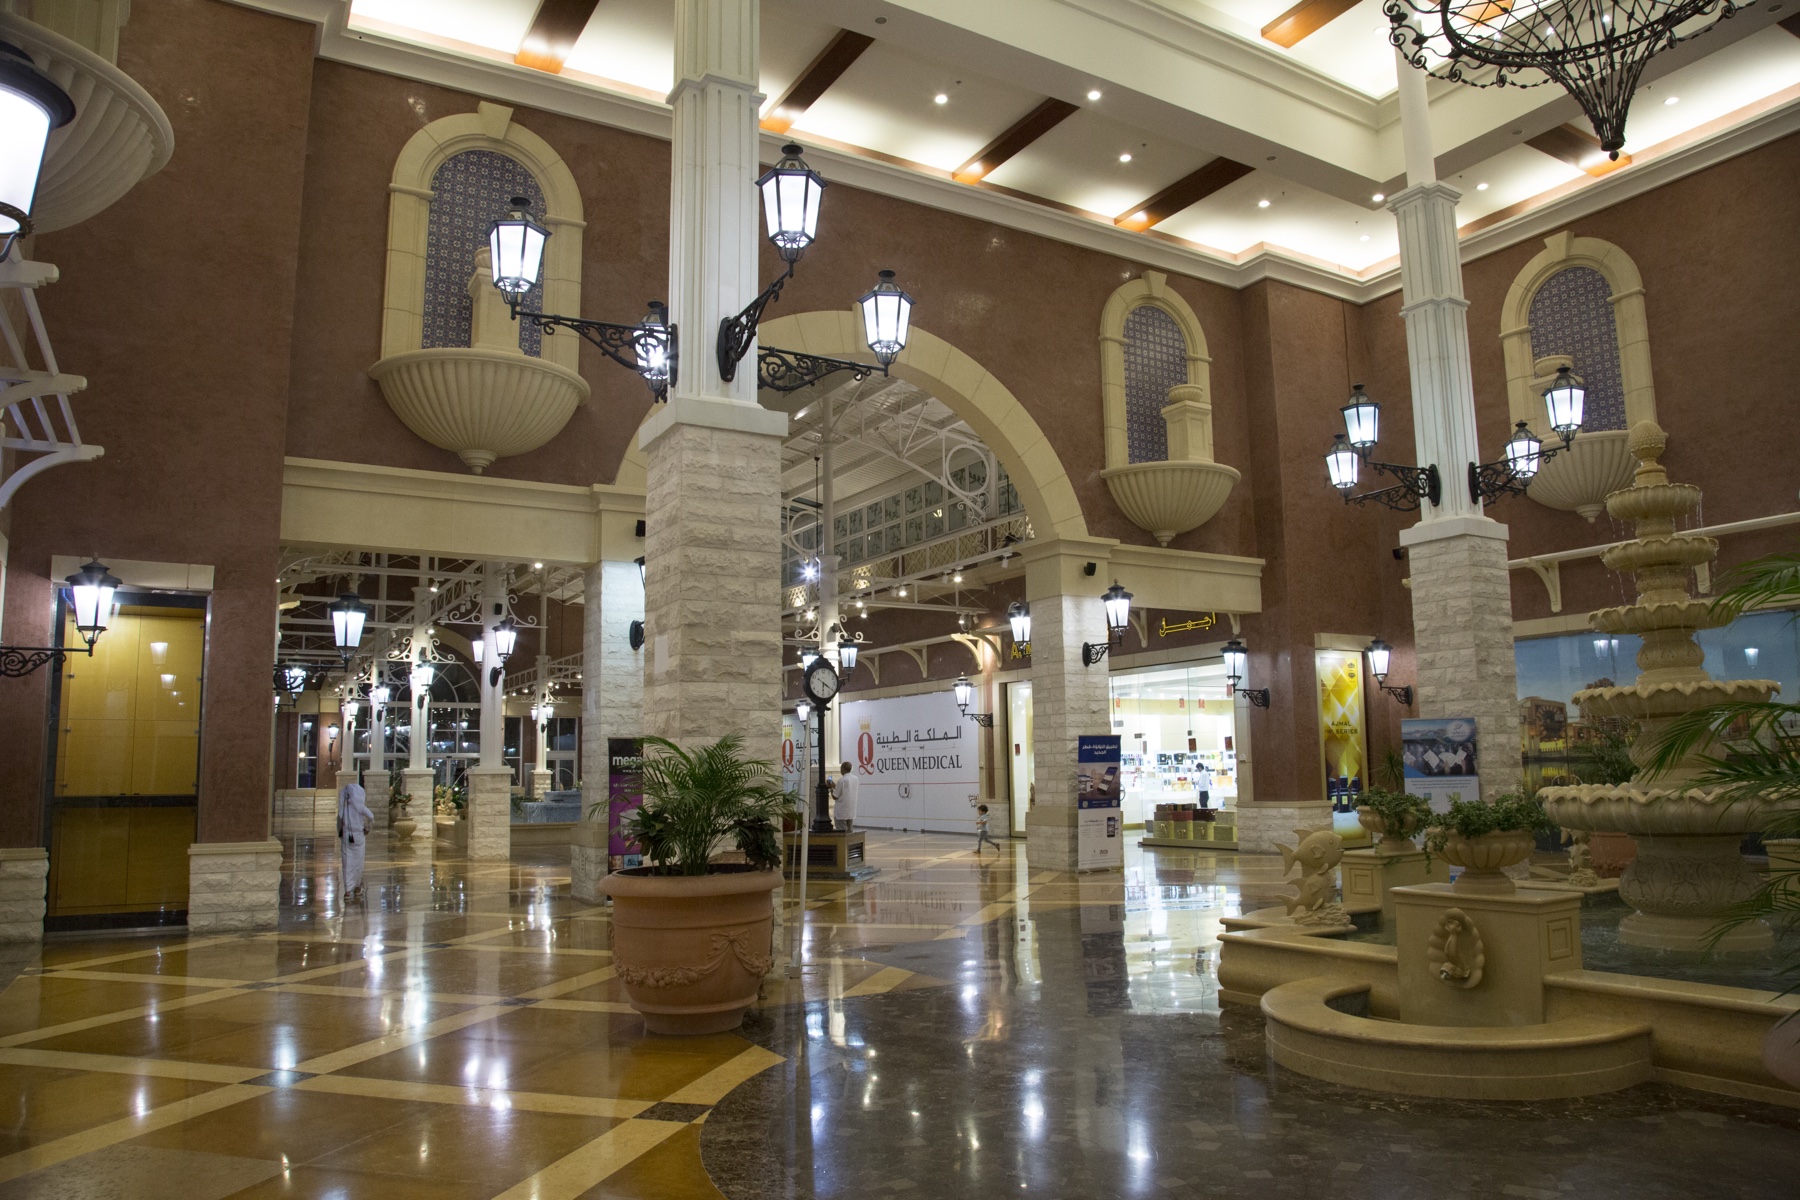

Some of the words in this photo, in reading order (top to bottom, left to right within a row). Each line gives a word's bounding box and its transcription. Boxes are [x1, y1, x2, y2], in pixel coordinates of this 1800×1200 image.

[876, 729, 912, 749] الطبية
[913, 725, 962, 743] الملكة
[876, 757, 910, 774] QUEEN
[912, 754, 963, 771] MEDICAL
